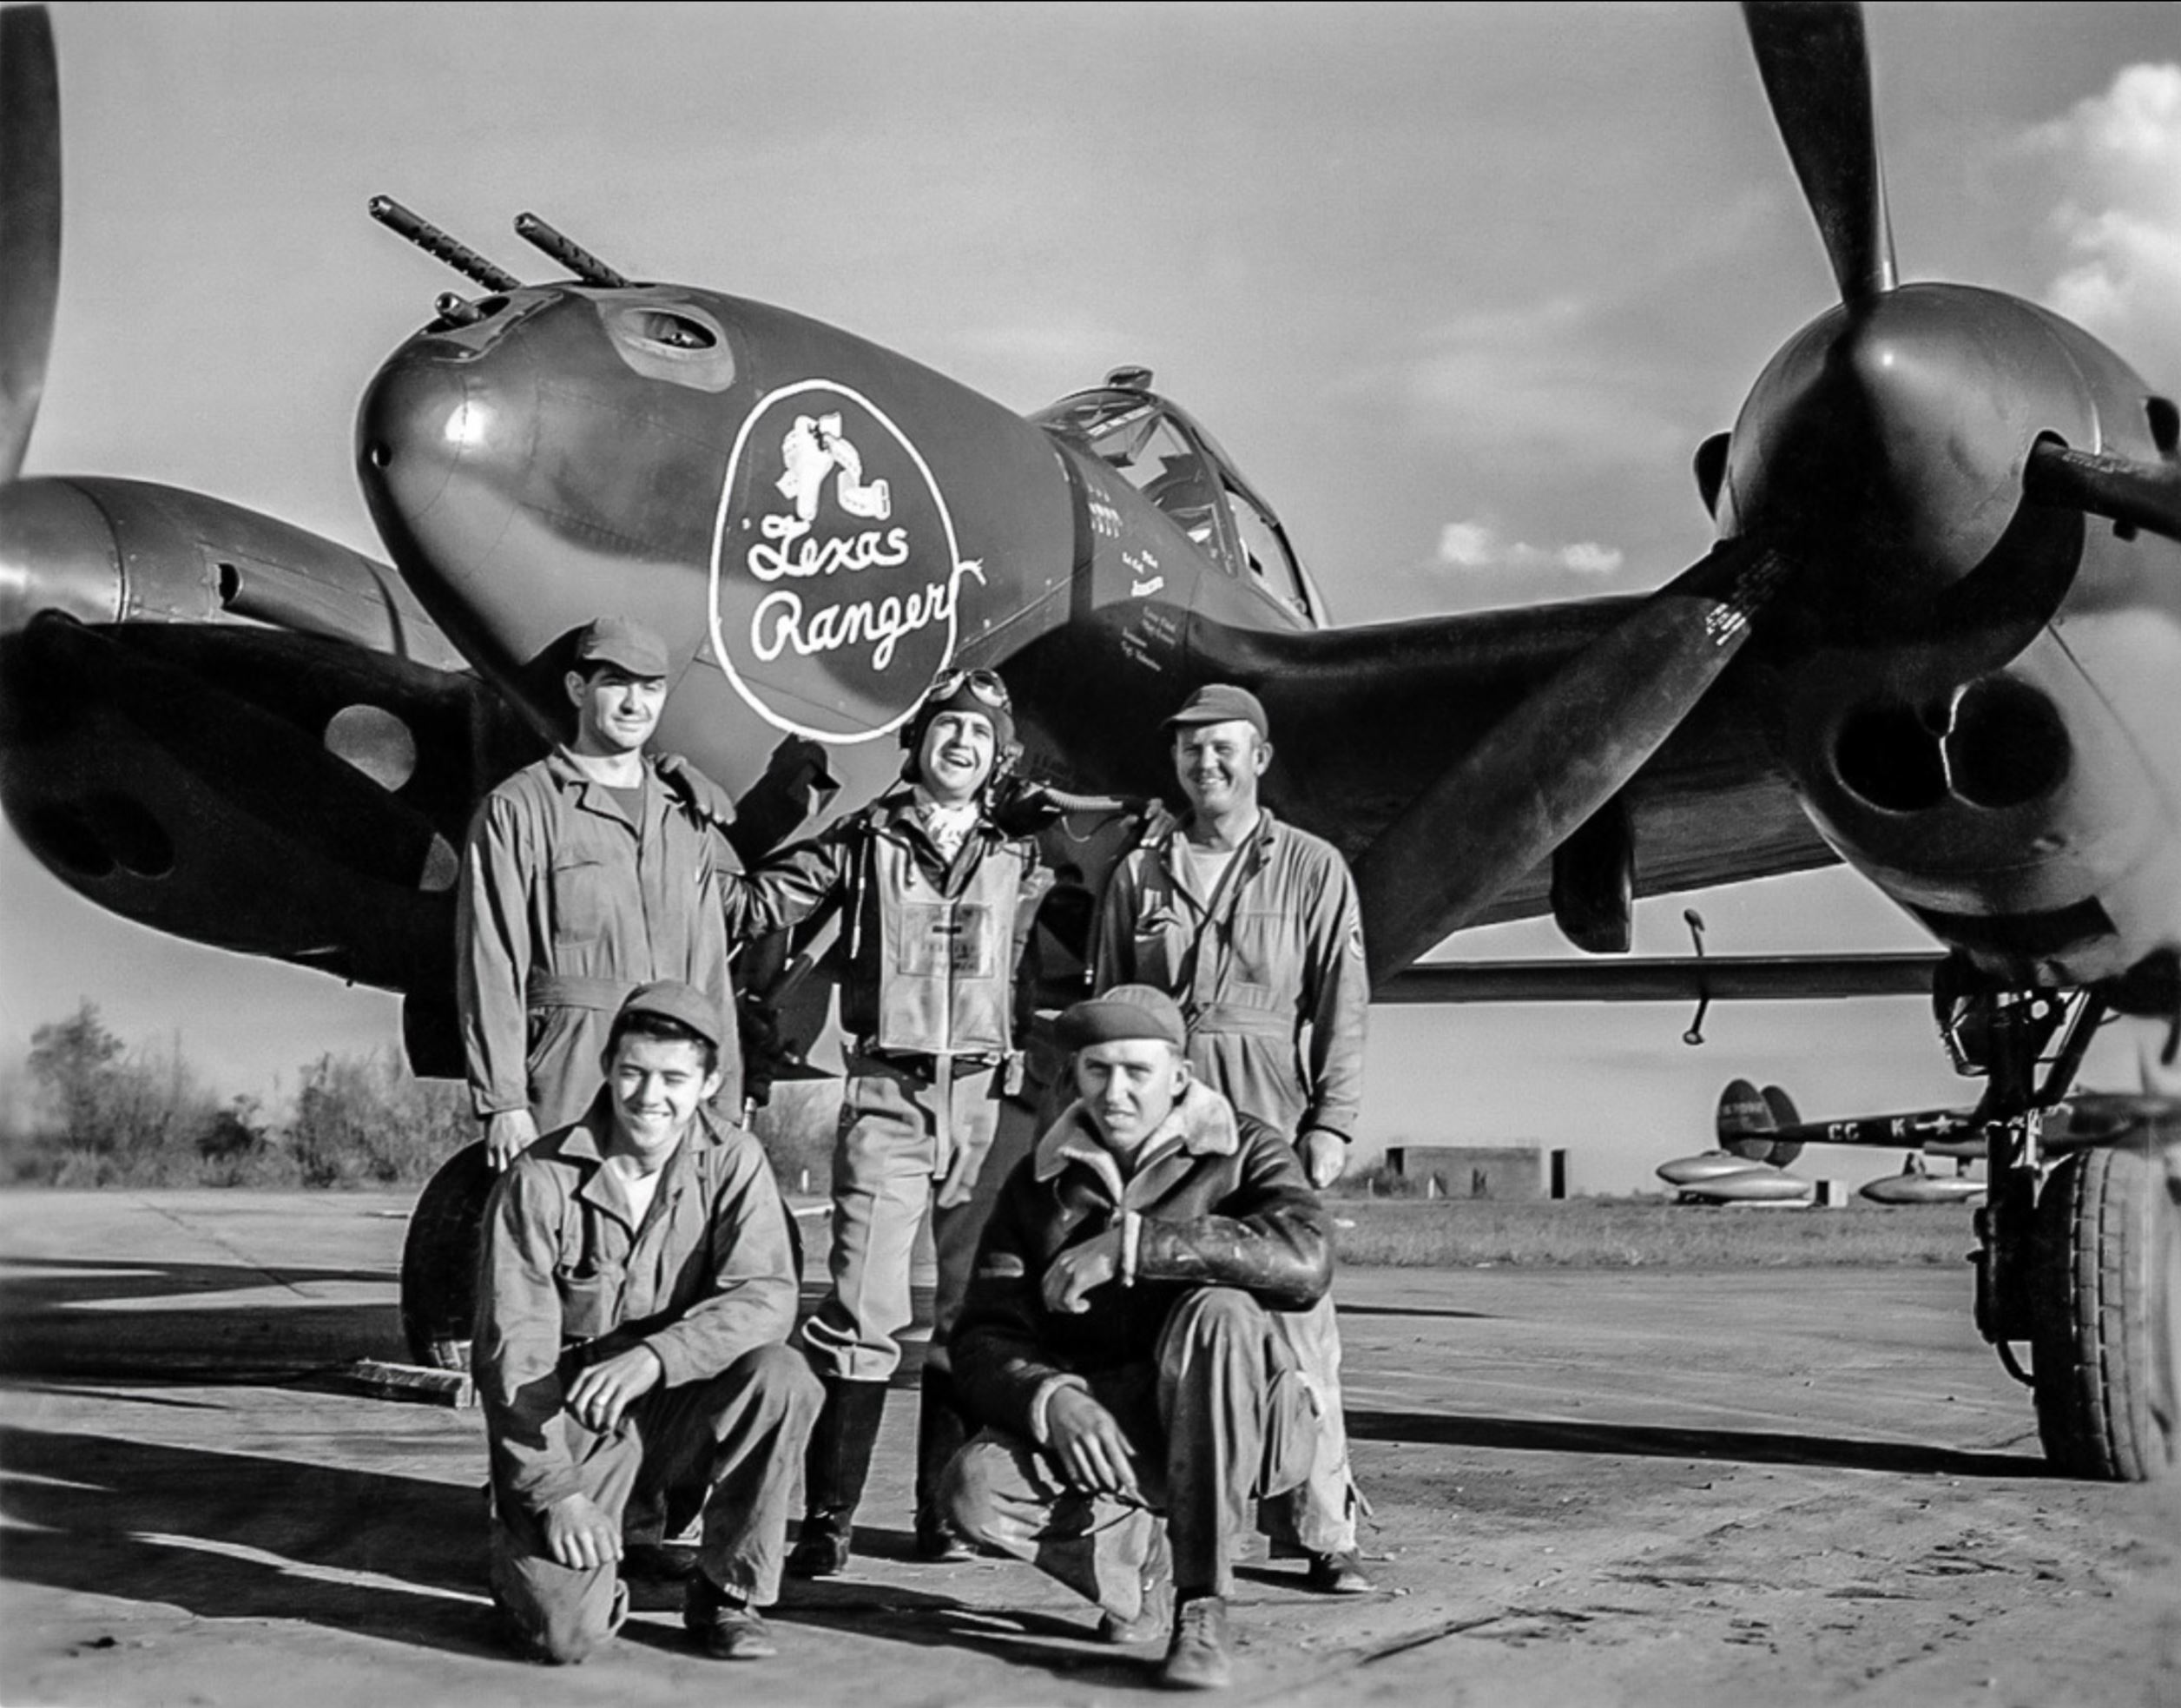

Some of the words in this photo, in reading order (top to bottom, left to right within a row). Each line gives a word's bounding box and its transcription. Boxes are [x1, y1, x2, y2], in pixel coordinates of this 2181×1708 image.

[748, 515, 909, 581] Texas
[751, 583, 954, 670] Ranger
[1892, 1118, 1906, 1137] K
